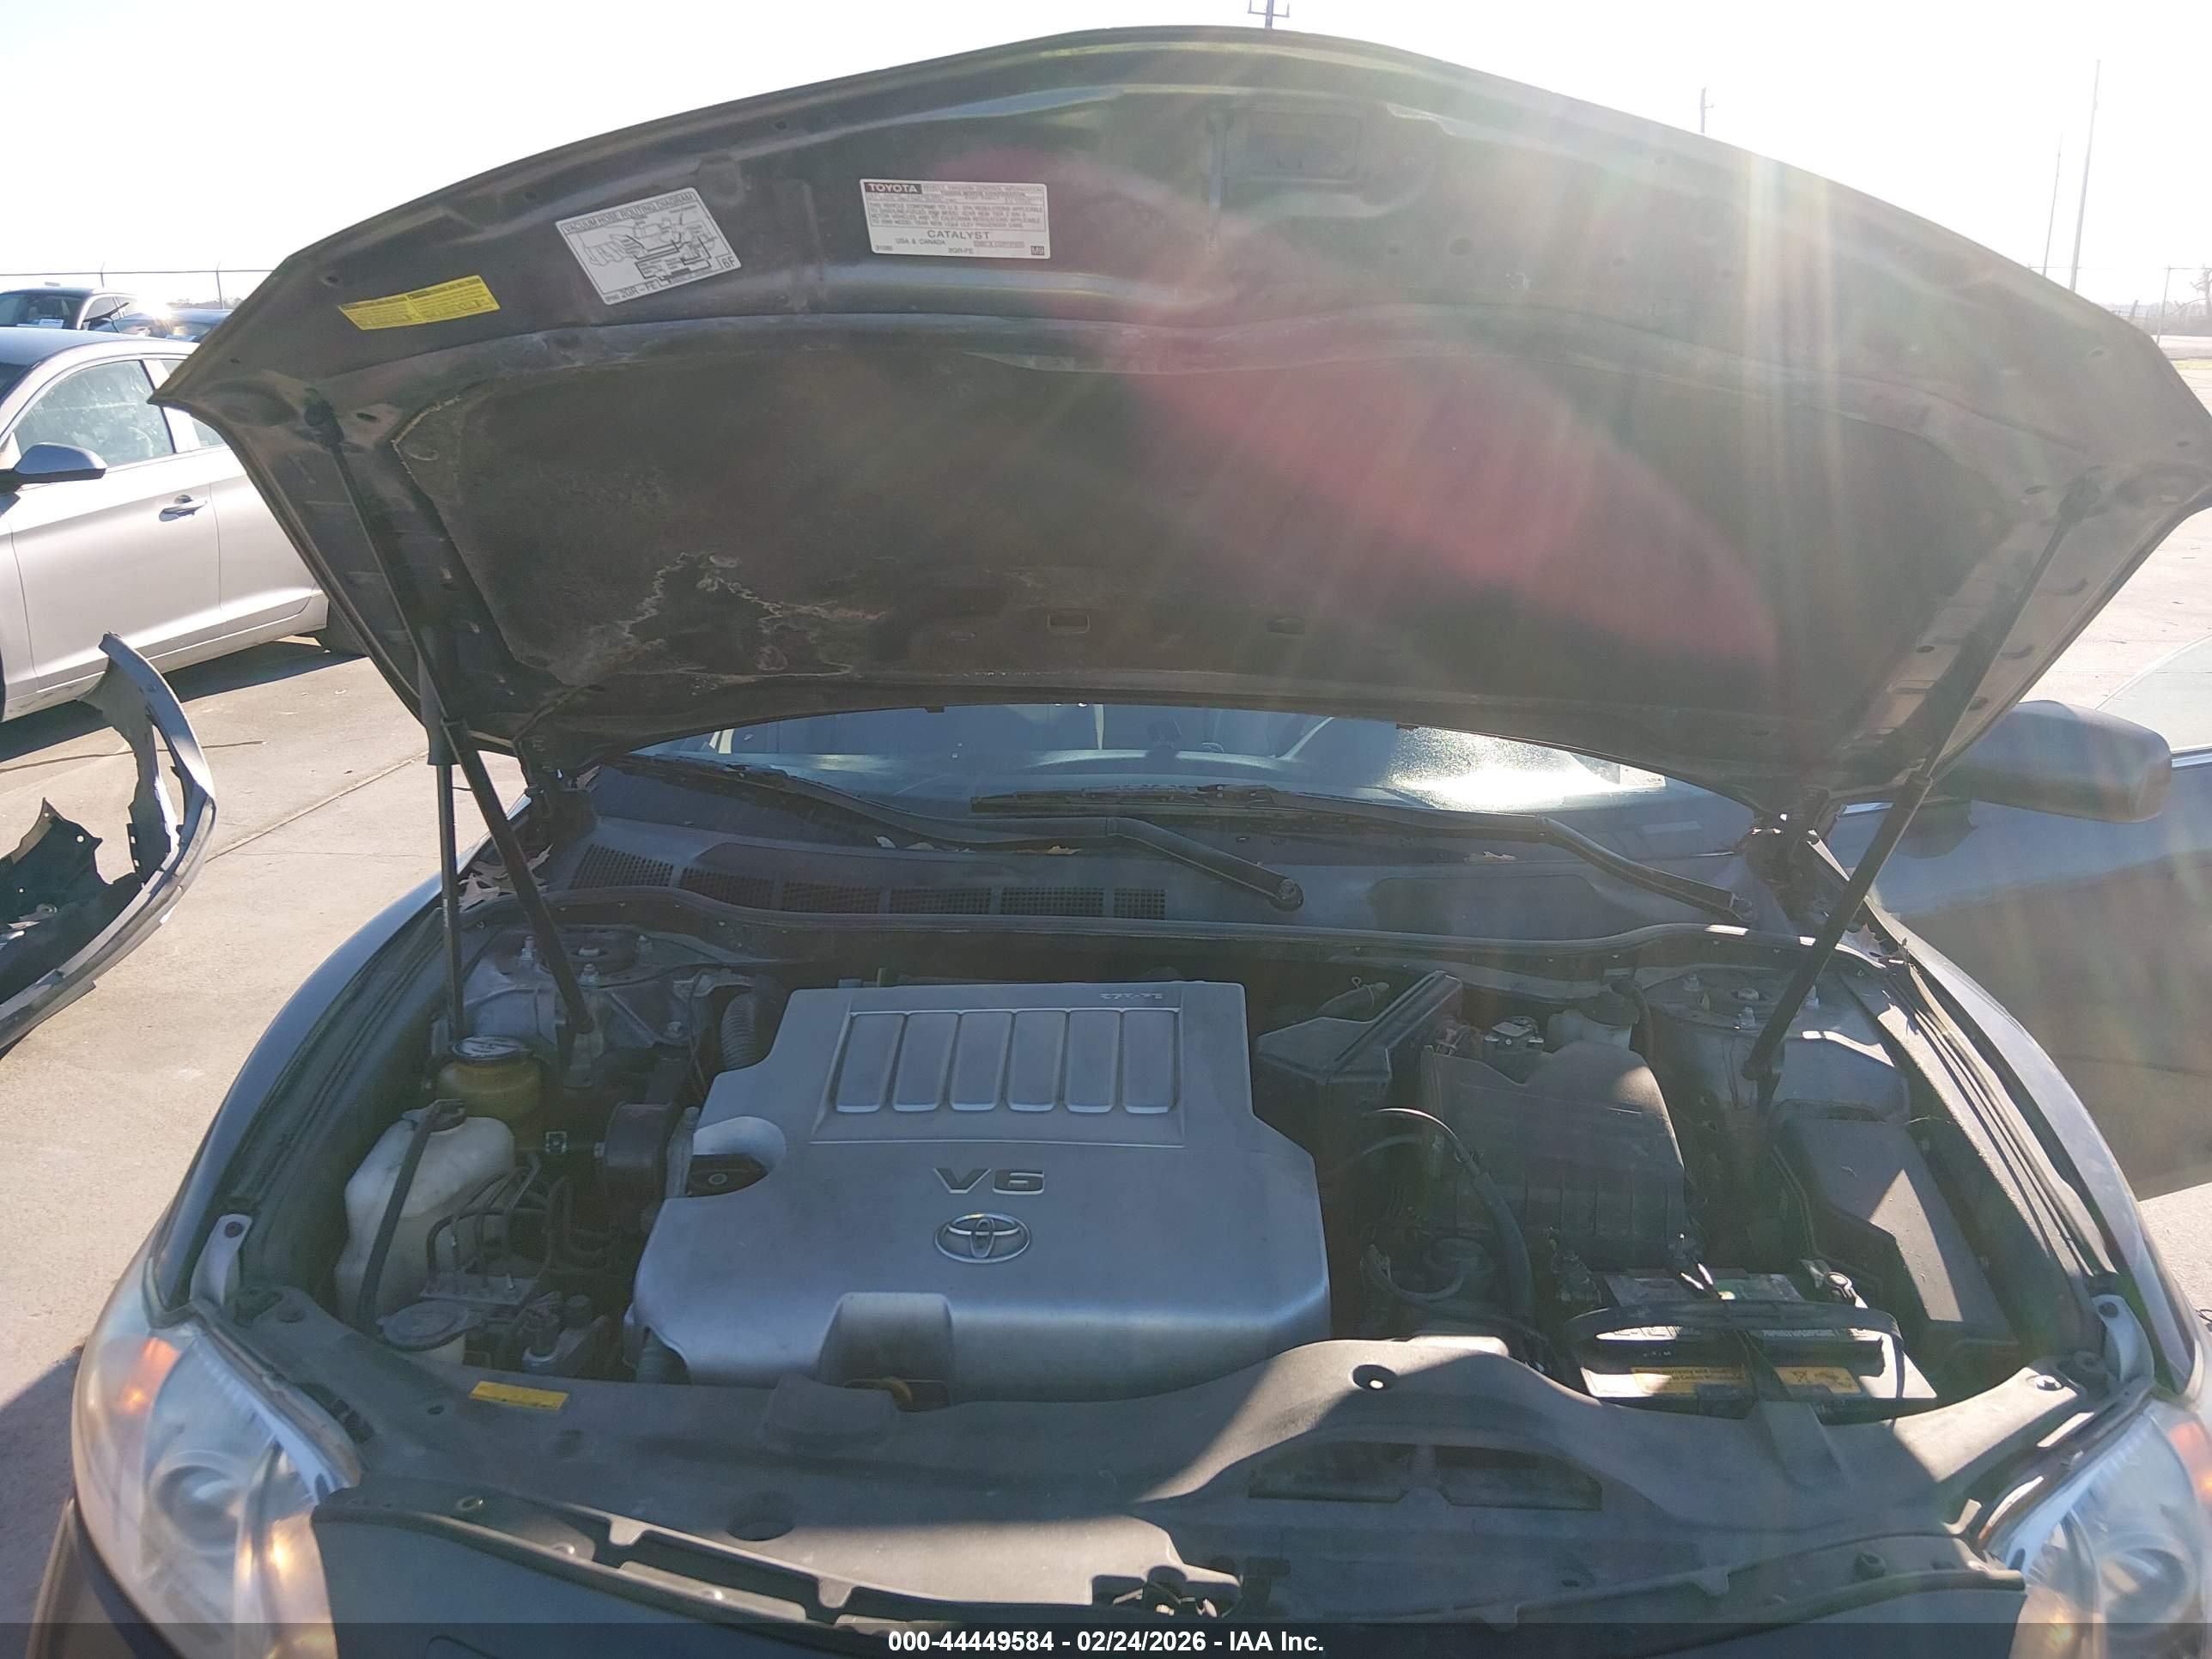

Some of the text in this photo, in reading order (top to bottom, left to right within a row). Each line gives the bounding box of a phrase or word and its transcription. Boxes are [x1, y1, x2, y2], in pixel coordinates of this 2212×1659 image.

[870, 183, 918, 193] TOYOTA
[927, 229, 989, 240] CATALYST
[933, 1168, 1044, 1194] V6
